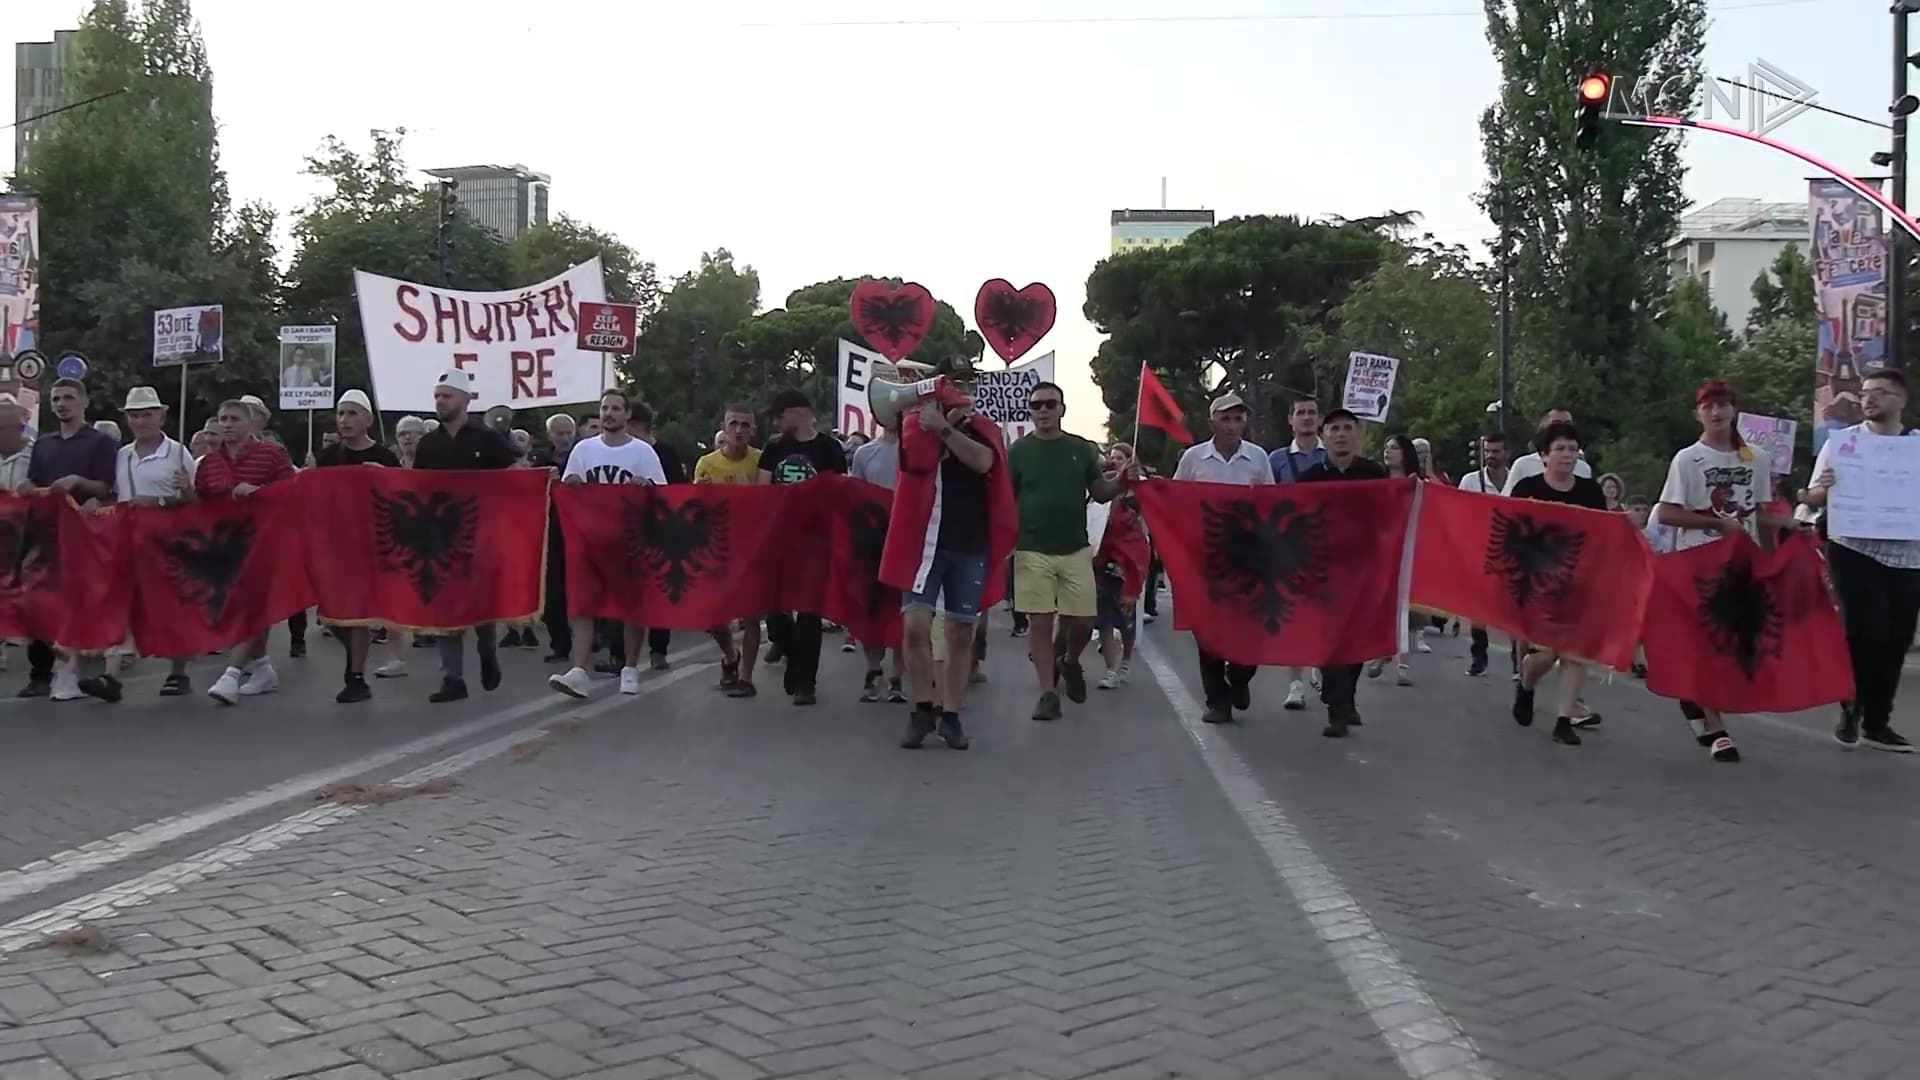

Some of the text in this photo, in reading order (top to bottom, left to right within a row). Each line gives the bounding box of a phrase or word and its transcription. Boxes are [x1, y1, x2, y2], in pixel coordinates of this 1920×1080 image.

[157, 313, 174, 335] 53
[595, 314, 619, 323] KEEP
[592, 321, 621, 331] CALM
[590, 335, 625, 347] RESIGN
[1355, 356, 1368, 367] EDI
[510, 348, 558, 399] RE
